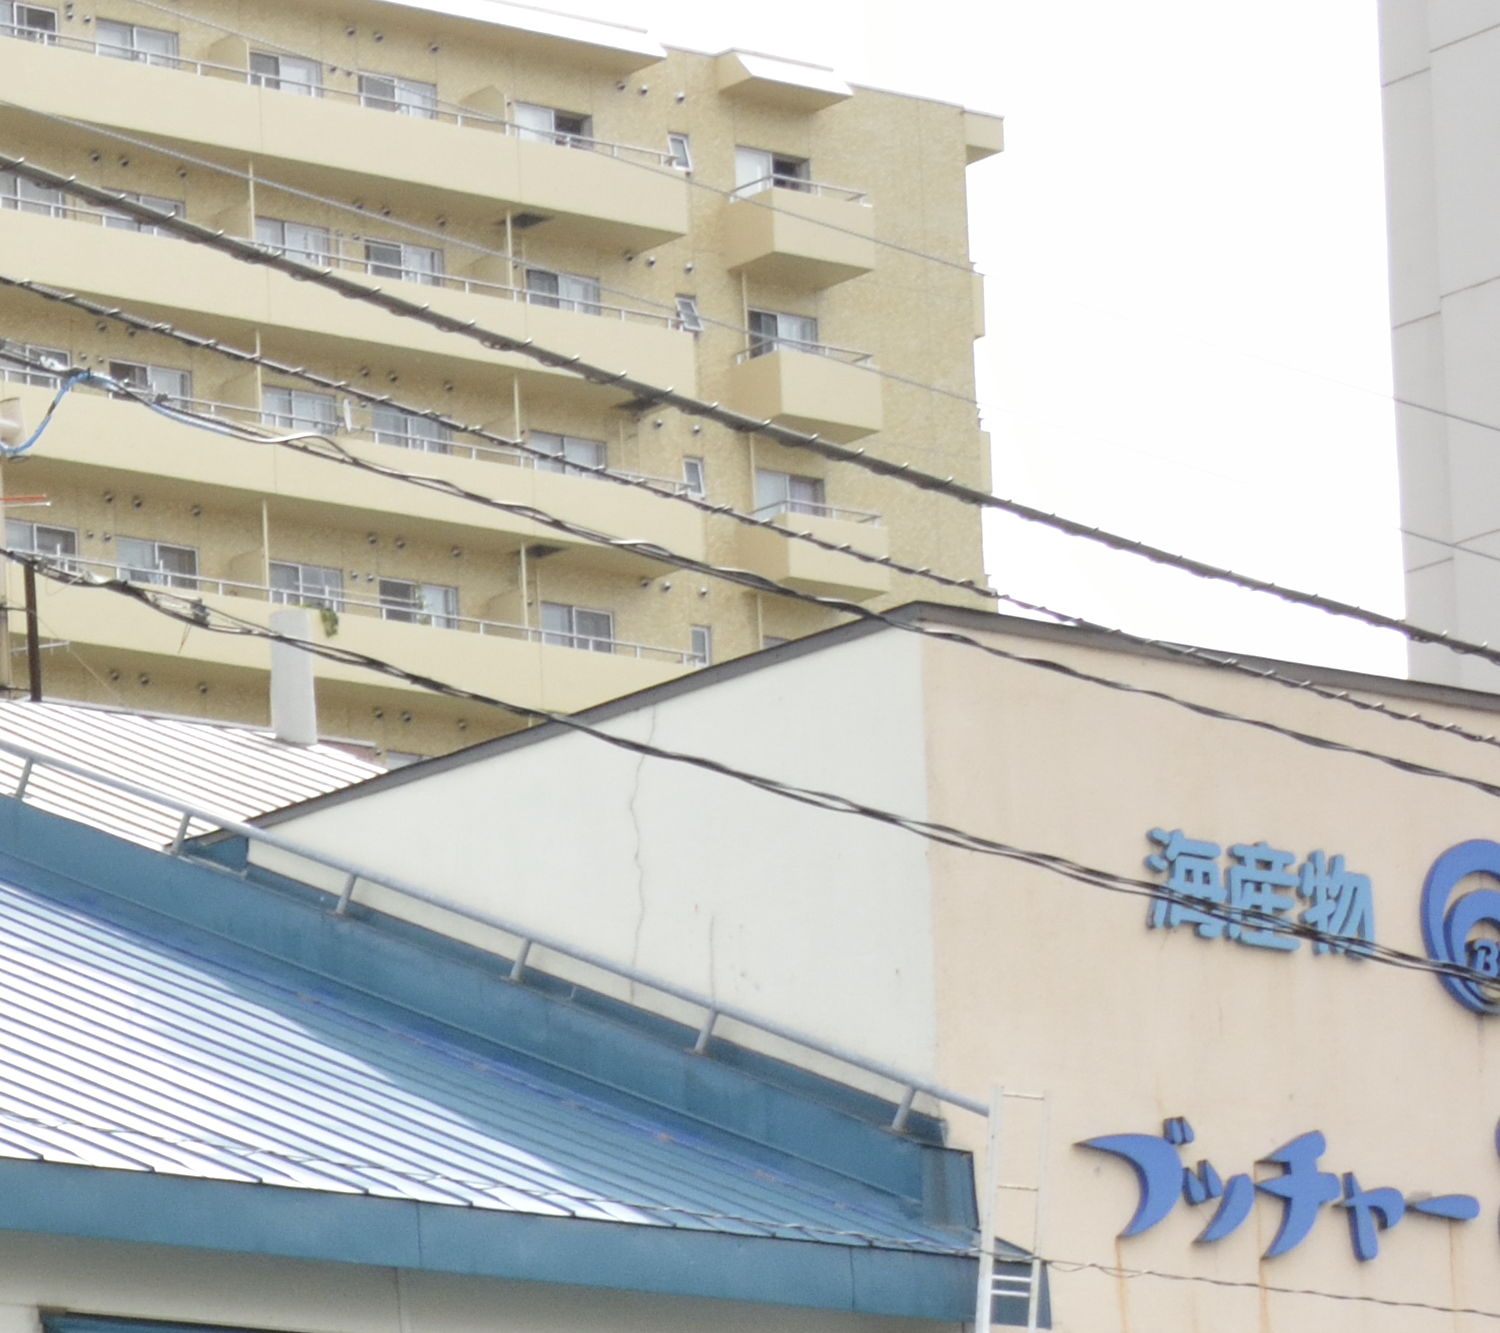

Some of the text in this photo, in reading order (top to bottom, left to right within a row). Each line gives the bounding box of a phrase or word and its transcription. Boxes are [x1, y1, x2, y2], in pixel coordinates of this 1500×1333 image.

[1143, 827, 1376, 960] 海産物
[1072, 1115, 1481, 1263] ブッチャー
